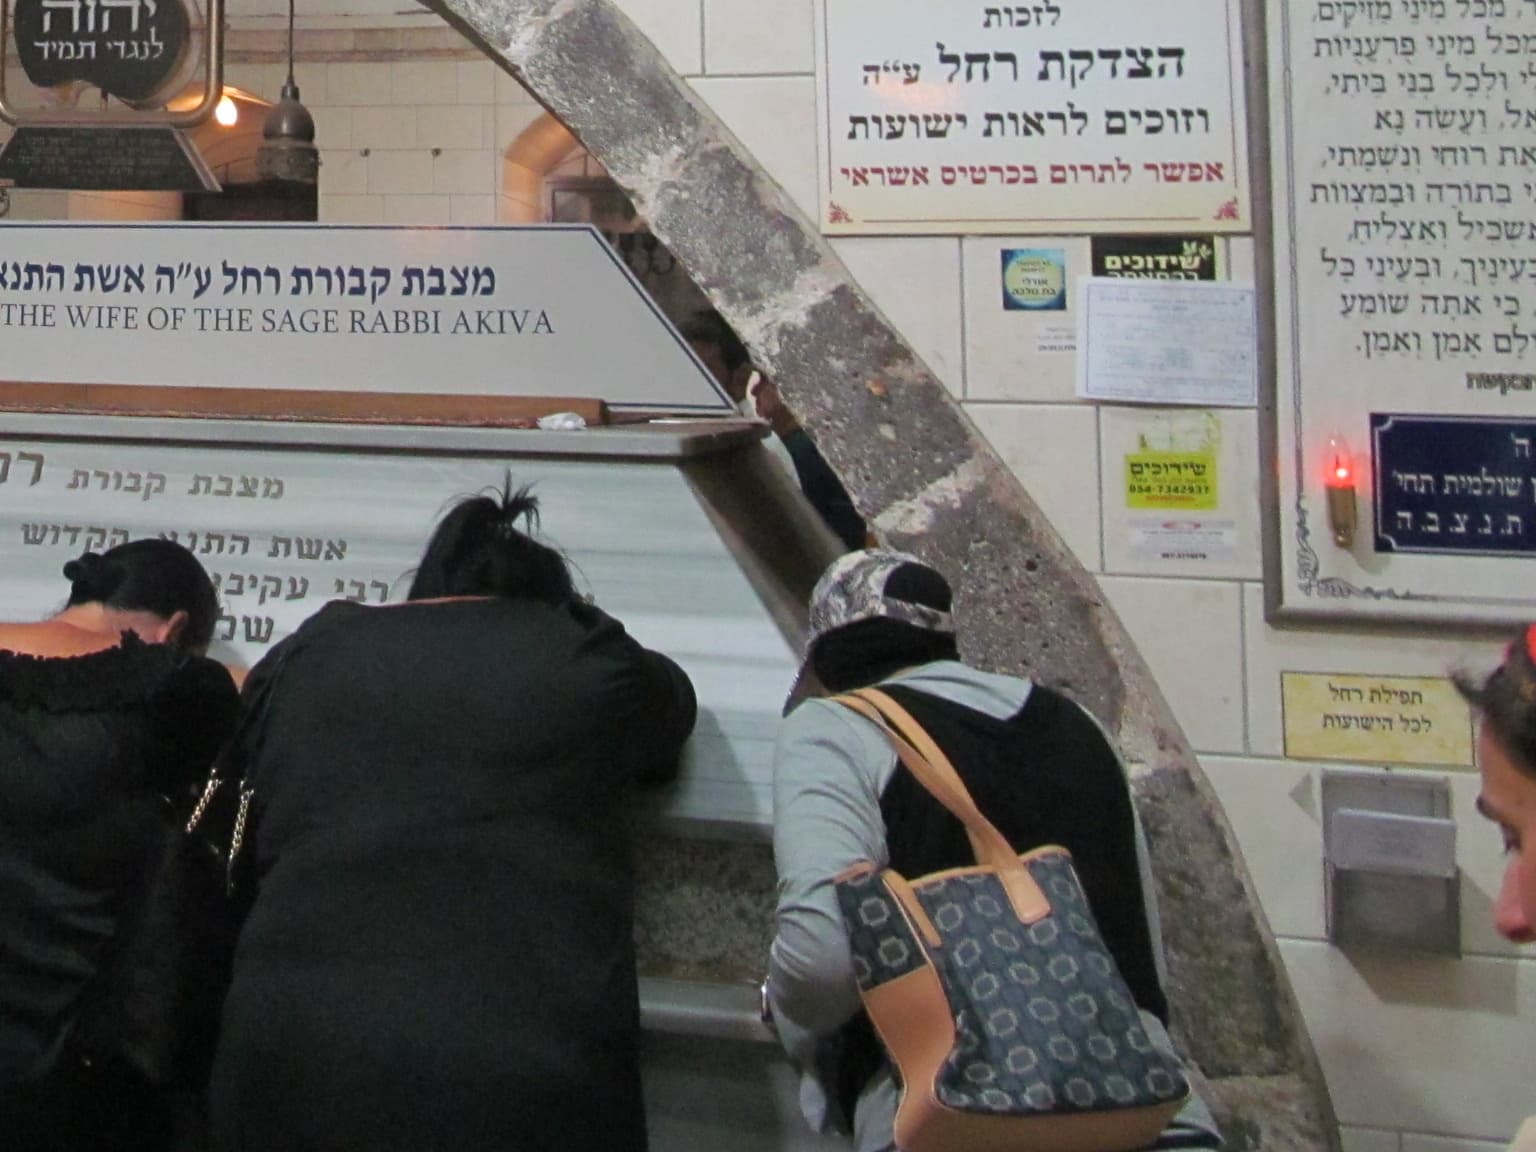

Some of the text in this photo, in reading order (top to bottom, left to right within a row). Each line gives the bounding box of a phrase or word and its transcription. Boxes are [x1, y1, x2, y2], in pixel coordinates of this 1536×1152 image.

[1401, 0, 1447, 21] מיני
[33, 27, 165, 61] לנגדי תמיד
[1426, 34, 1476, 57] מיני
[936, 41, 1019, 84] רחל
[1037, 46, 1186, 88] הצדקת
[1444, 61, 1509, 94] ולכל
[1397, 72, 1435, 96] בני
[846, 102, 1210, 141] וזוכים לראות ישועות
[1374, 109, 1406, 134] נא
[1414, 108, 1488, 133] ועשה
[839, 156, 1225, 187] אפשר לתרום בכרטיס אשראי
[1431, 146, 1487, 168] רוחי
[1425, 181, 1513, 205] בתורה
[1104, 254, 1202, 270] שידוכים
[1320, 247, 1356, 279] כל
[1366, 256, 1442, 281] ובעיני
[73, 261, 146, 295] אשת
[155, 261, 213, 301] ע"ה
[221, 259, 282, 296] רחל
[290, 264, 392, 305] קבורת
[401, 264, 496, 297] מצבת
[0, 303, 57, 329] THE
[65, 304, 140, 332] WIFE
[147, 306, 187, 332] OF
[194, 307, 255, 334] THE
[261, 308, 341, 335] SAGE
[348, 309, 442, 336] RABBI
[450, 310, 557, 337] AKIVA
[1339, 293, 1521, 319] כי אתה שומע
[1432, 330, 1482, 360] אמן
[1129, 461, 1207, 476] שידוכים
[1443, 466, 1523, 497] שולמית
[67, 467, 168, 501] קבורת
[187, 472, 286, 500] מצבת
[21, 521, 130, 556] הקדוש
[267, 534, 348, 562] אשת
[333, 576, 389, 602] רבי
[1328, 682, 1424, 706] תפילת רחל
[1321, 713, 1433, 734] לכל הישועות
